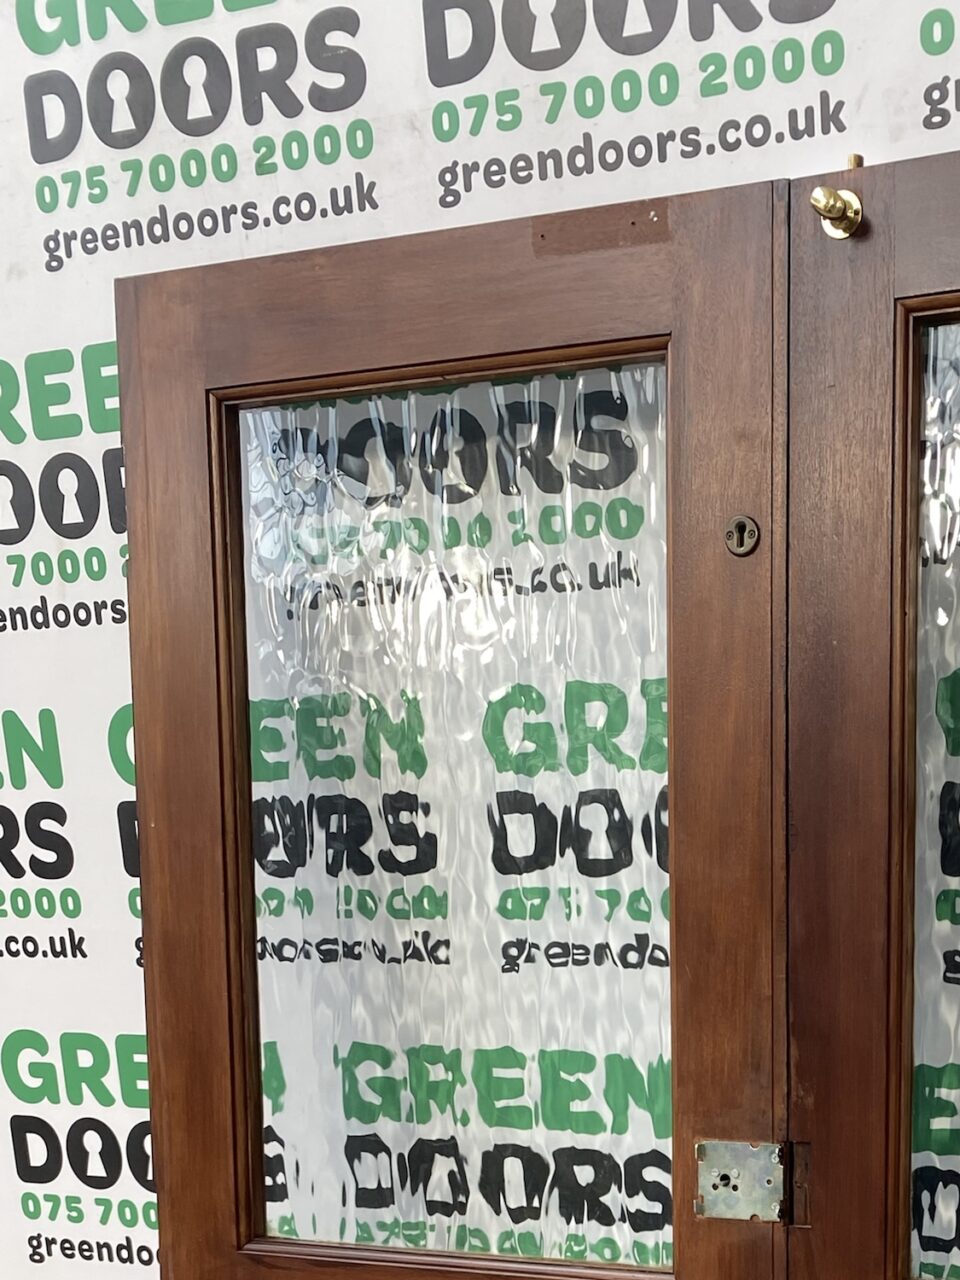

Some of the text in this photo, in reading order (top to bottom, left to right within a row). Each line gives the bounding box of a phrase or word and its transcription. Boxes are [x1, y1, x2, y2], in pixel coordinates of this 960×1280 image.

[23, 6, 367, 165] DOORS
[422, 0, 837, 88] DOO
[432, 29, 845, 143] 075 7000 2000
[35, 118, 374, 214] 075 7000 2000
[438, 90, 848, 208] greendoors.co.uk
[43, 171, 379, 273] greendoors.co.uk
[6, 547, 107, 587] 7000
[335, 1040, 671, 1139] GREEN
[21, 1192, 84, 1224] 075
[27, 1233, 160, 1266] greendo
